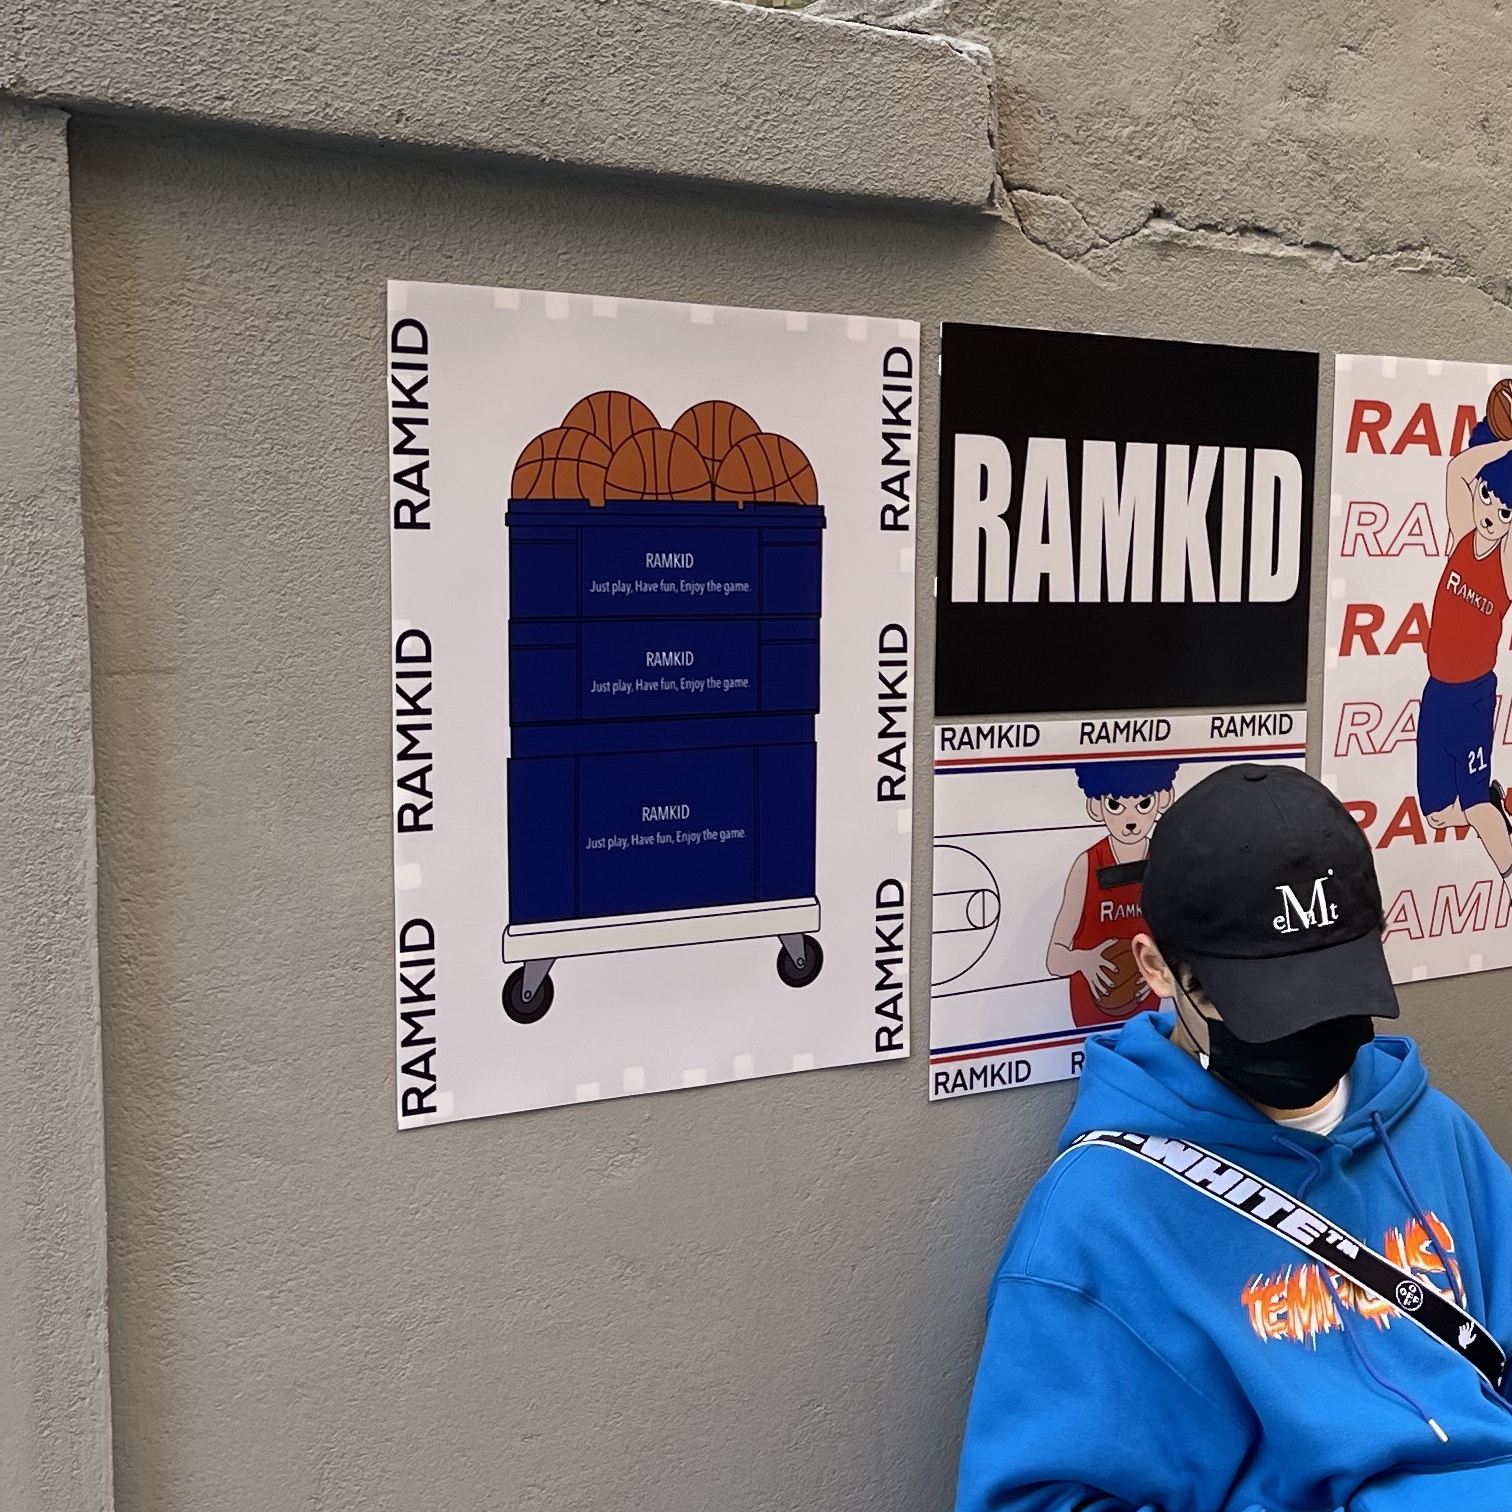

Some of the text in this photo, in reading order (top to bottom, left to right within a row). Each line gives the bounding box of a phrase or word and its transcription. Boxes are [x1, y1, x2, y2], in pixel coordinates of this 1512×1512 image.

[391, 316, 430, 531] RAMKID
[881, 346, 913, 532] RAMKID
[951, 433, 1303, 603] RAMKID
[645, 553, 694, 569] RAMKID
[590, 580, 610, 593] Just
[635, 580, 658, 592] Have
[660, 579, 679, 594] fun,
[680, 580, 705, 595] Enjoy
[707, 580, 722, 592] the
[1446, 571, 1494, 615] RAMKID
[646, 651, 694, 667] RAMKID
[591, 680, 610, 693] Just
[635, 679, 658, 691] Have
[660, 677, 679, 691] fun,
[680, 677, 705, 693] Enjoy
[707, 676, 721, 689] the
[395, 626, 433, 833] RAMKID
[877, 622, 908, 802] RAMKID
[940, 713, 1293, 752] RAMKID RAMKID RAMKID
[1468, 747, 1488, 774] 21
[642, 804, 690, 822] RAMKID
[586, 837, 606, 850] Just
[631, 834, 655, 846] Have
[676, 830, 701, 845] Enjoy
[702, 829, 718, 841] the
[875, 876, 904, 1052] RAMKID
[399, 916, 437, 1117] RAMKID
[933, 1060, 1032, 1096] RAMKID
